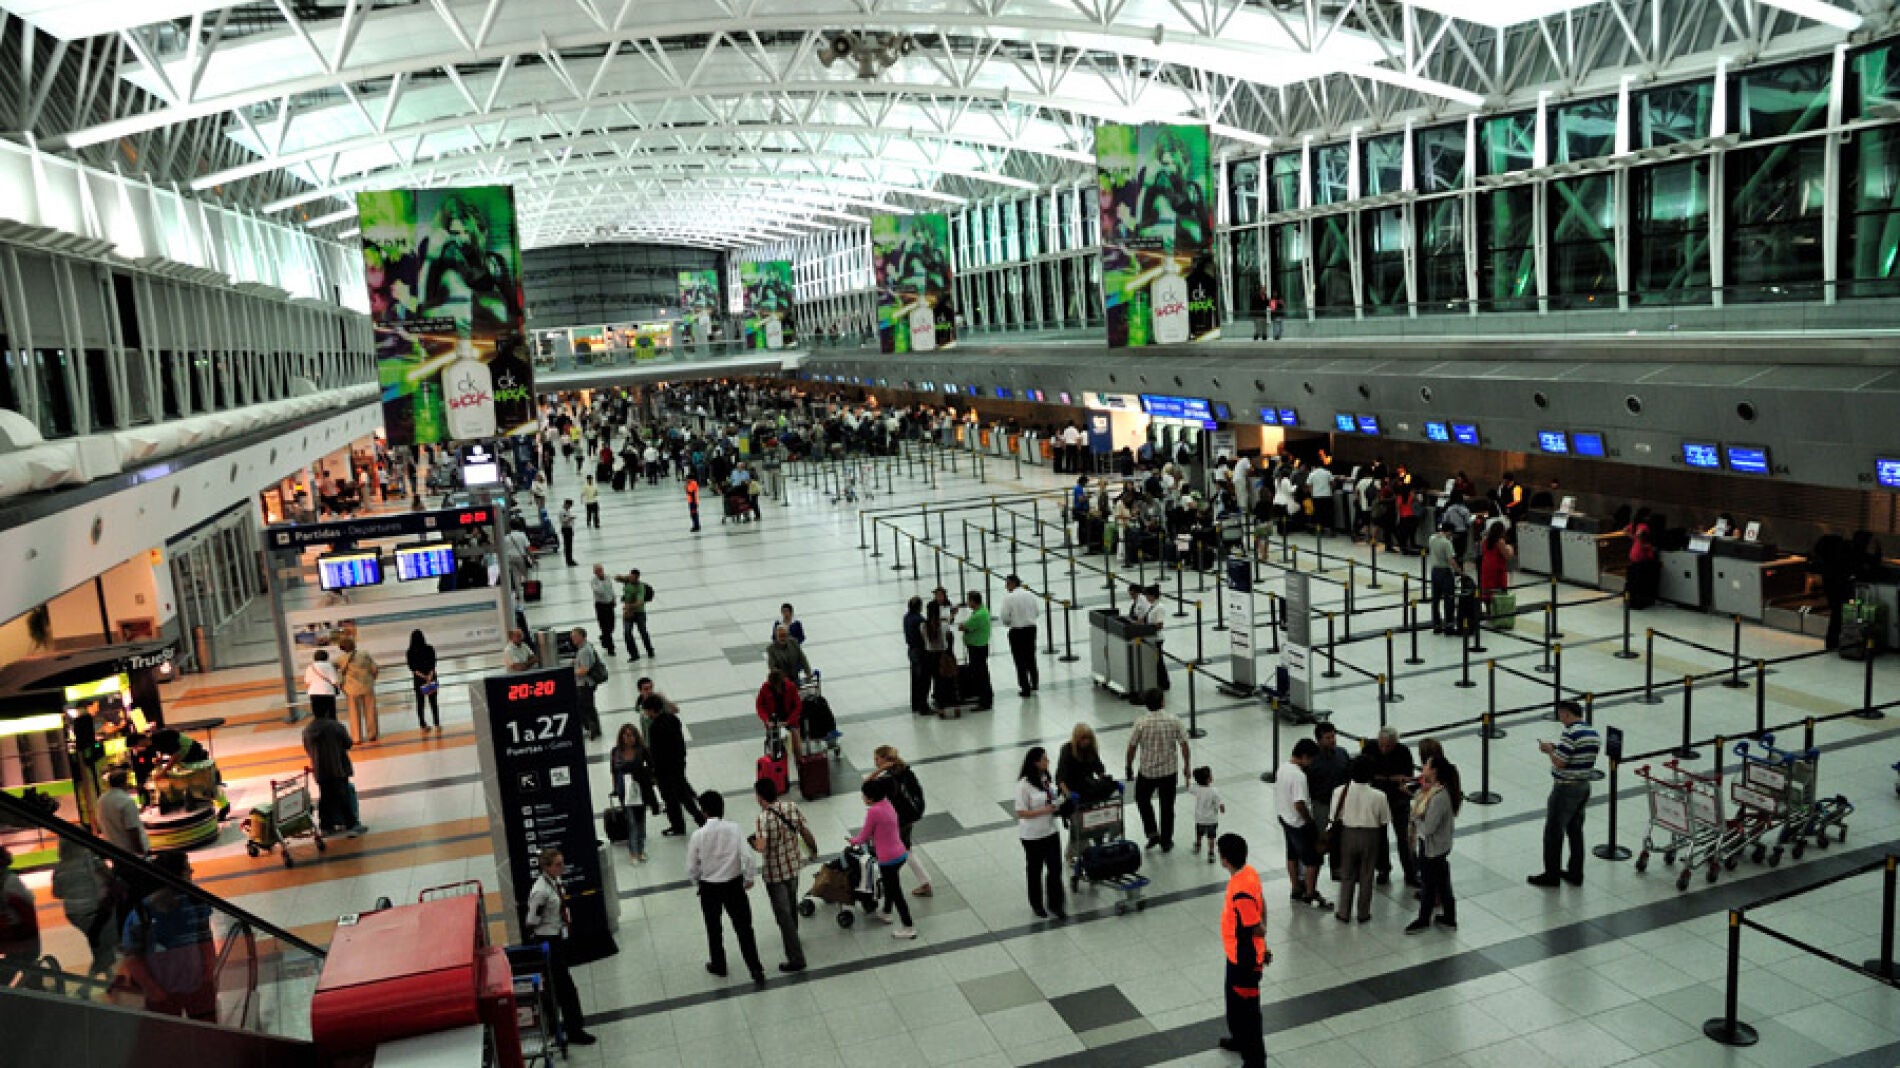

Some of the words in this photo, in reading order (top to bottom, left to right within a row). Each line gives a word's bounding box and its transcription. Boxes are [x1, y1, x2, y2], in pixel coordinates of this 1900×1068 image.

[458, 371, 479, 392] ck
[498, 368, 518, 389] ck
[508, 679, 555, 701] 20:20
[506, 720, 520, 743] 1
[523, 728, 535, 742] a
[536, 712, 569, 740] 27
